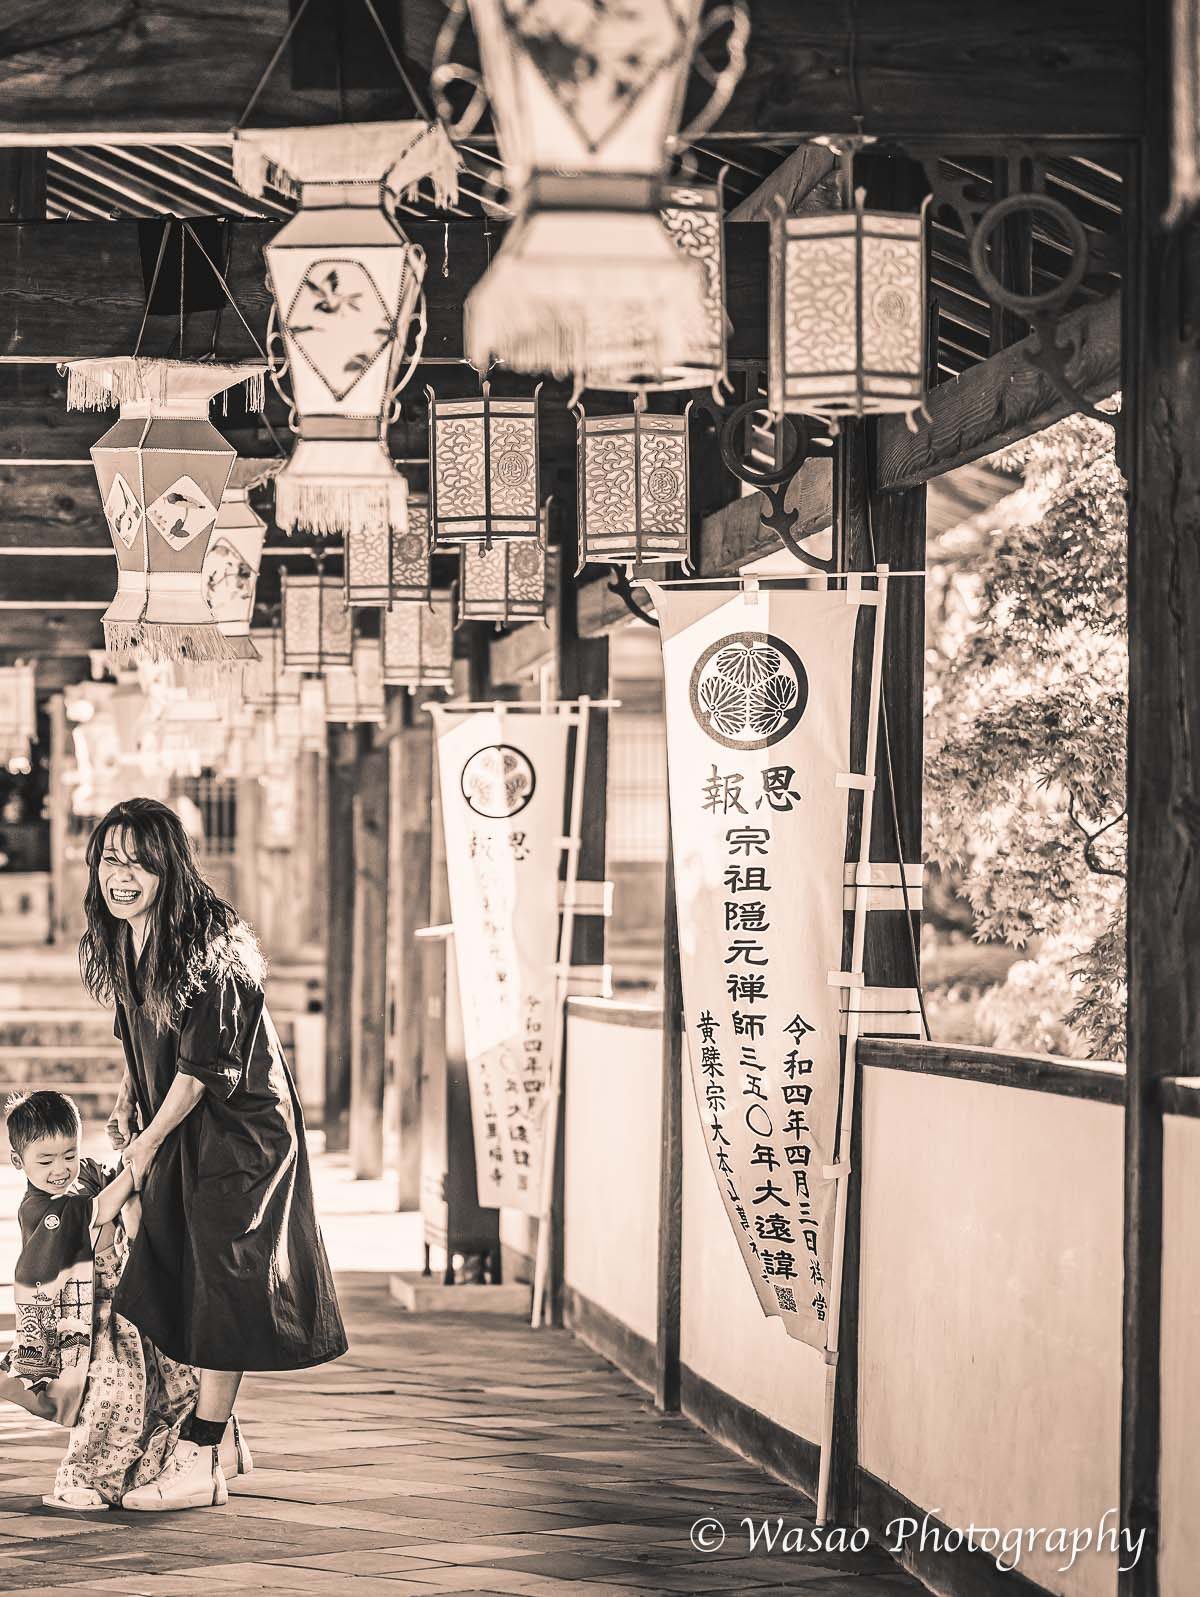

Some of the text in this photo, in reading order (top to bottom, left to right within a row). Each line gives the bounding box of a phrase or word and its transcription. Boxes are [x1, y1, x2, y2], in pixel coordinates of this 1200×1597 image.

[696, 1009, 770, 1284] 黄檗宗大本山
